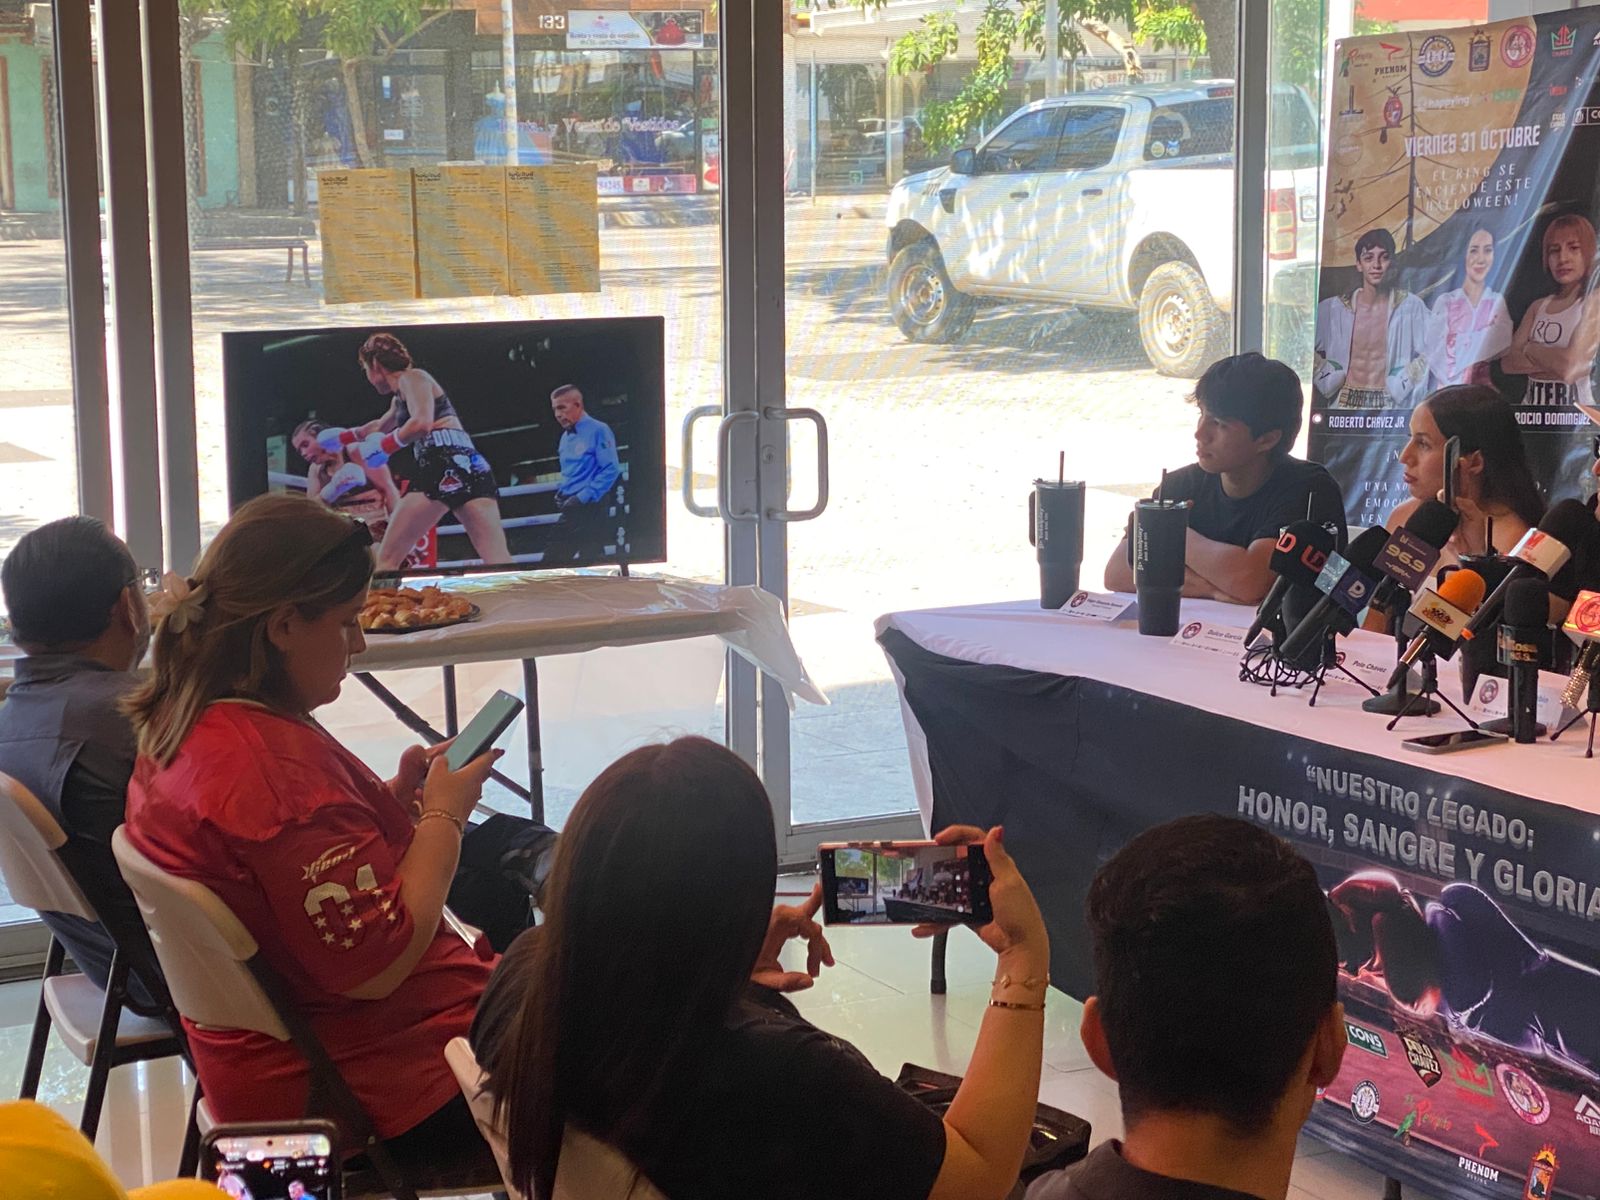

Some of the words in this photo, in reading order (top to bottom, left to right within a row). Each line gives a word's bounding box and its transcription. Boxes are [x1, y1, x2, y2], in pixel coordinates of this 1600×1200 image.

[538, 15, 565, 29] 133
[1375, 65, 1407, 75] PHENOM
[1405, 133, 1457, 157] VIERNES
[1461, 131, 1476, 153] 31
[1481, 125, 1541, 151] OCTUBRE
[1433, 169, 1449, 181] EL
[1456, 166, 1491, 180] RING
[1499, 163, 1516, 176] SE
[1416, 180, 1487, 198] ENCIENDE
[1496, 177, 1532, 192] ESTE
[1329, 416, 1364, 428] ROBERTO
[1366, 416, 1394, 429] CHAVEZ
[1394, 416, 1405, 428] JR
[1515, 412, 1542, 425] ROCIO
[1365, 482, 1388, 492] UNA
[1361, 513, 1383, 524] VEN
[1386, 544, 1426, 572] 96.9
[1208, 629, 1224, 637] Dulce
[1427, 797, 1535, 848] LEGADO:
[1237, 785, 1335, 847] HONOR,
[1343, 813, 1455, 875] SANGRE
[1465, 848, 1485, 884] Y
[1494, 859, 1600, 921] GLORIA
[1348, 1025, 1382, 1048] CONS
[1403, 1037, 1434, 1059] POLO
[1408, 1050, 1441, 1074] CHAVEZ
[1458, 1156, 1499, 1182] PHENOM
